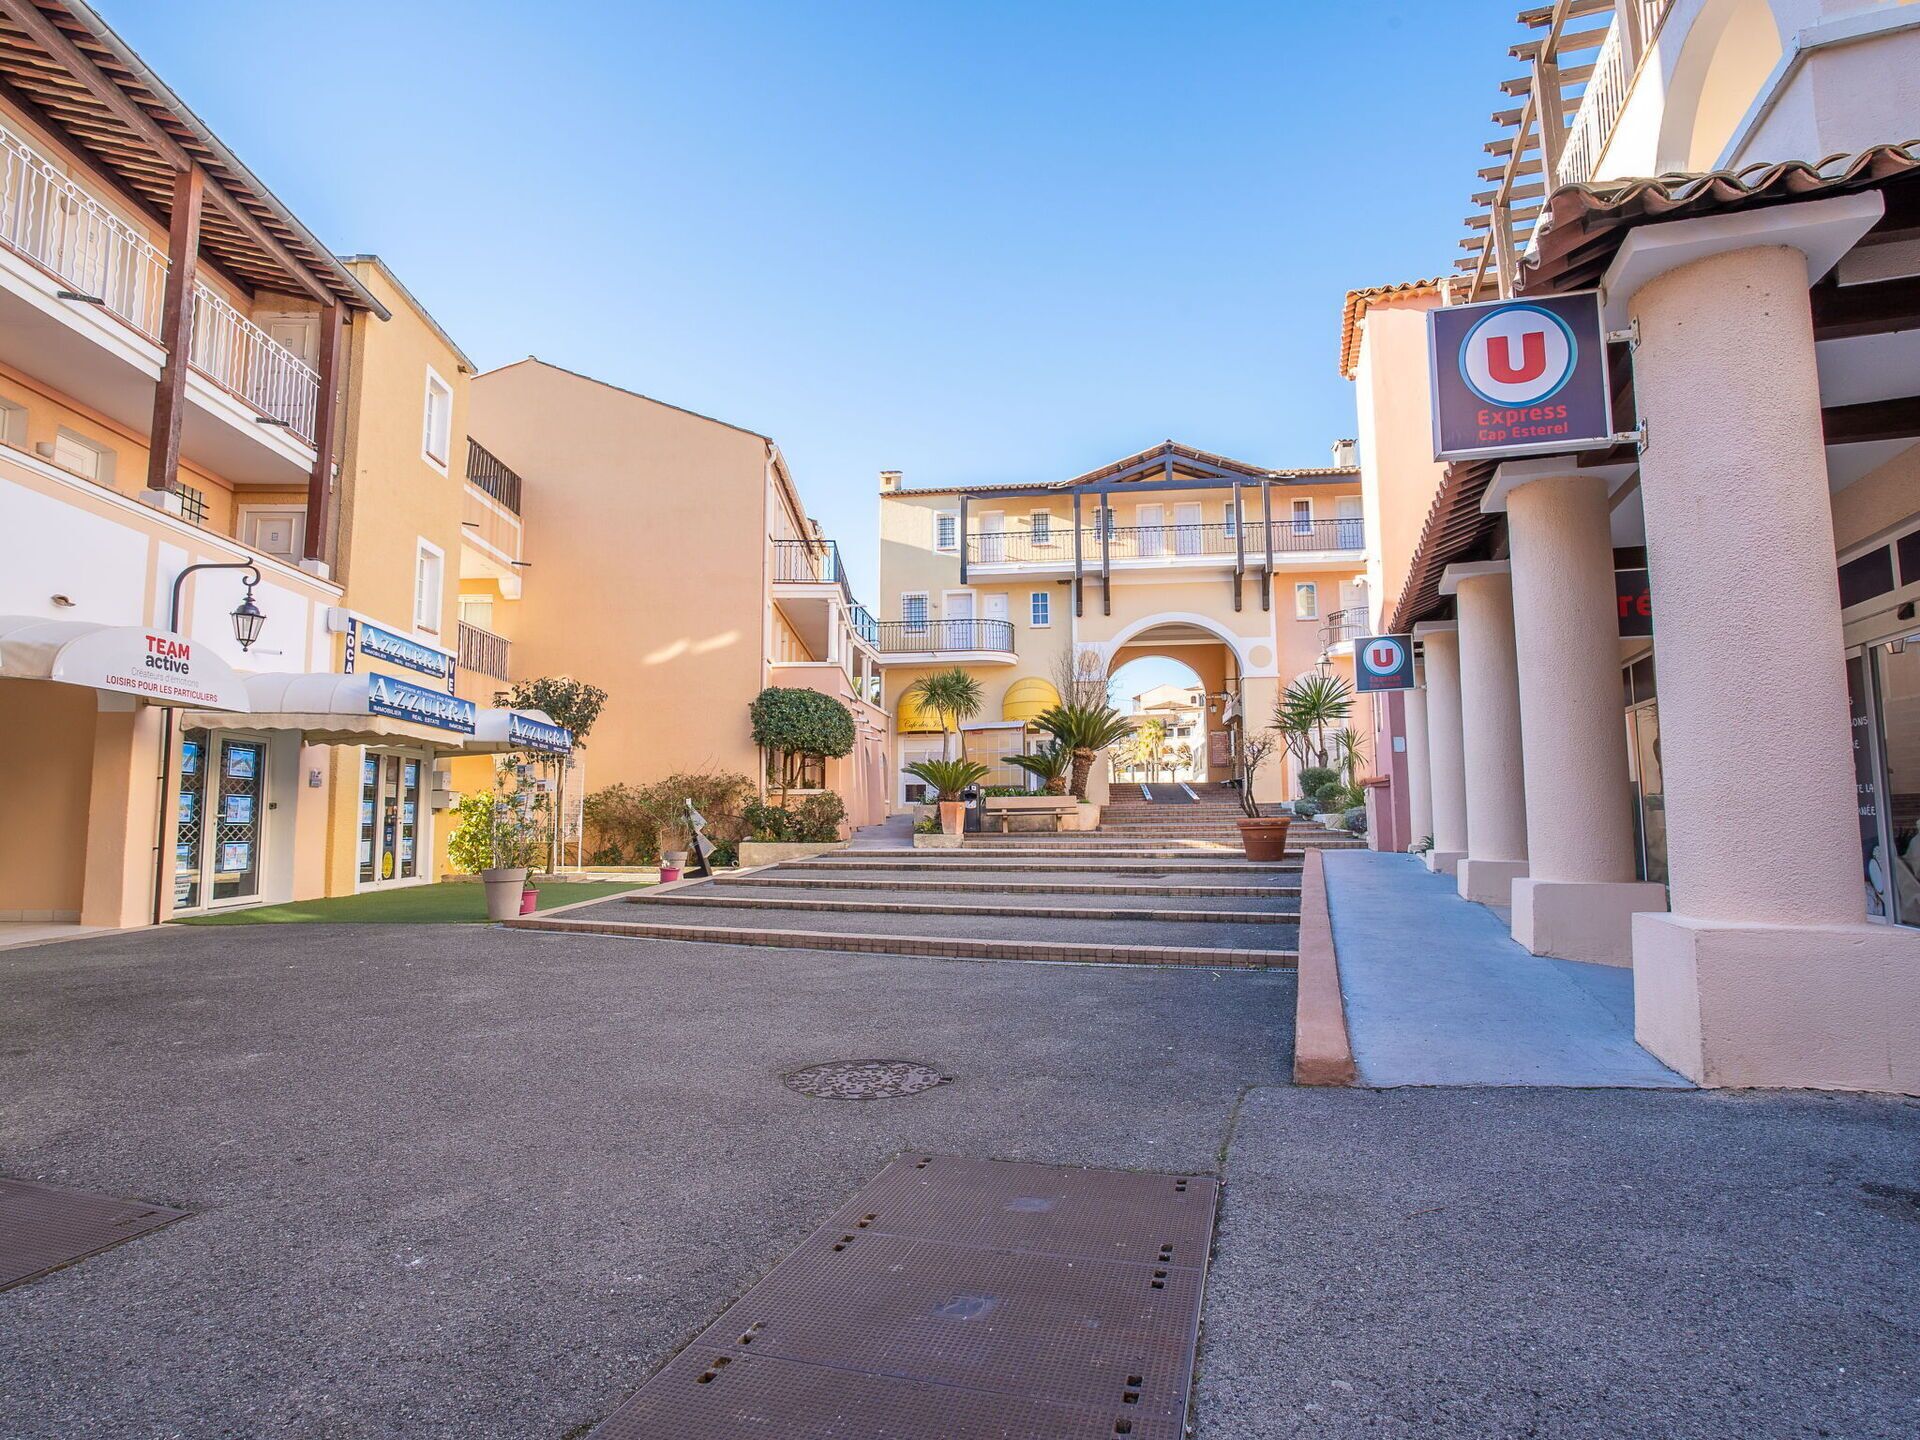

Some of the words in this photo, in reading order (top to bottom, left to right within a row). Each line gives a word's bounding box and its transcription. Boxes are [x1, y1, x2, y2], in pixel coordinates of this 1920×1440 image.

[1486, 331, 1547, 385] U
[1477, 405, 1568, 427] Express
[1479, 428, 1507, 441] Cap
[1511, 421, 1569, 438] Esterel
[145, 635, 190, 660] TEAM
[345, 621, 355, 674] LOCA
[361, 628, 446, 673] AZZURRA
[1373, 648, 1394, 667] U
[145, 654, 190, 675] active
[106, 674, 137, 688] LOISIRS
[138, 680, 161, 692] POUR
[160, 684, 176, 695] LES
[173, 687, 218, 703] PARTICULIERS
[369, 678, 476, 726] AZZURRA
[509, 715, 572, 748] AZZURRA
